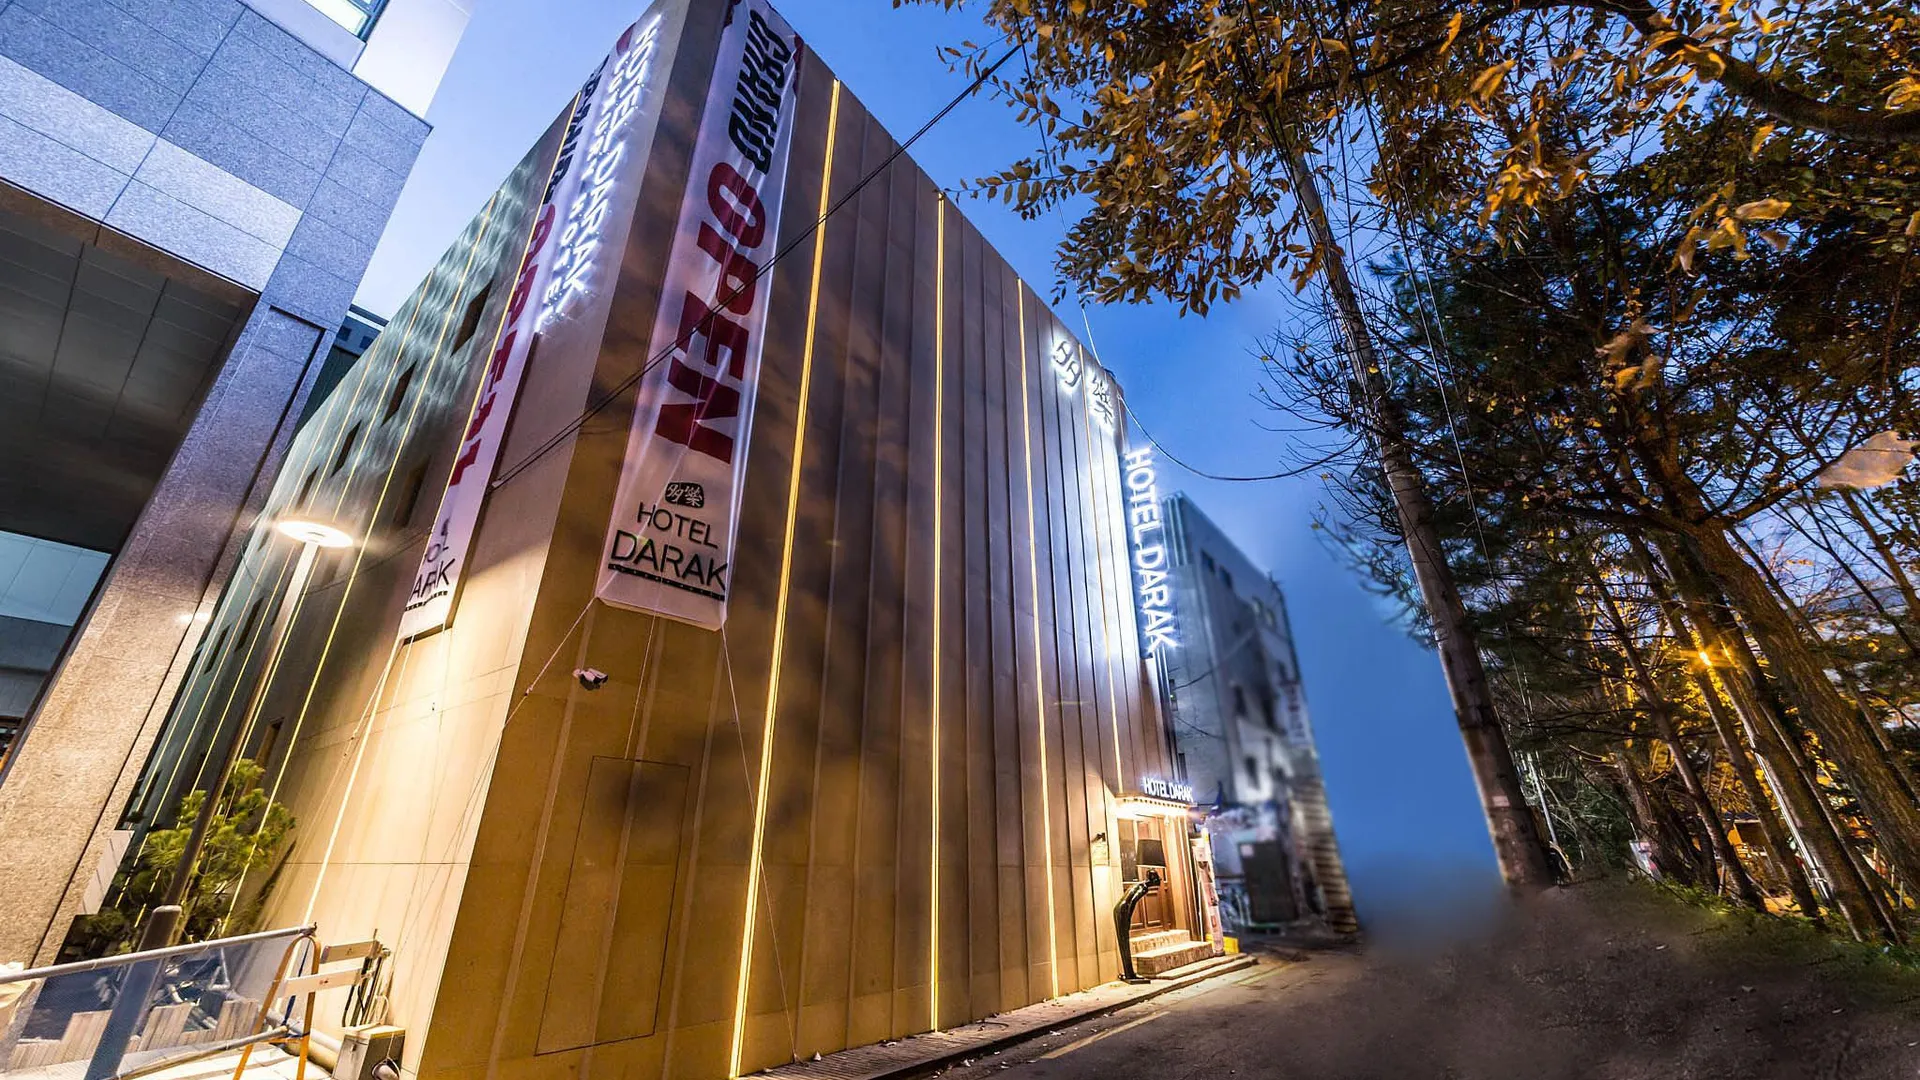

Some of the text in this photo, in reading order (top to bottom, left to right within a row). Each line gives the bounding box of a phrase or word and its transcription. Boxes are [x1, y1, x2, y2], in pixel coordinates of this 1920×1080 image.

[555, 14, 662, 314] HOTEL DARAK
[728, 9, 792, 175] GRAND
[655, 161, 767, 465] OPEN
[610, 530, 729, 591] DARAK
[637, 502, 718, 549] HOTEL
[1125, 447, 1178, 654] HOTEL DARAK
[1143, 776, 1194, 803] HOTEL DARAK
